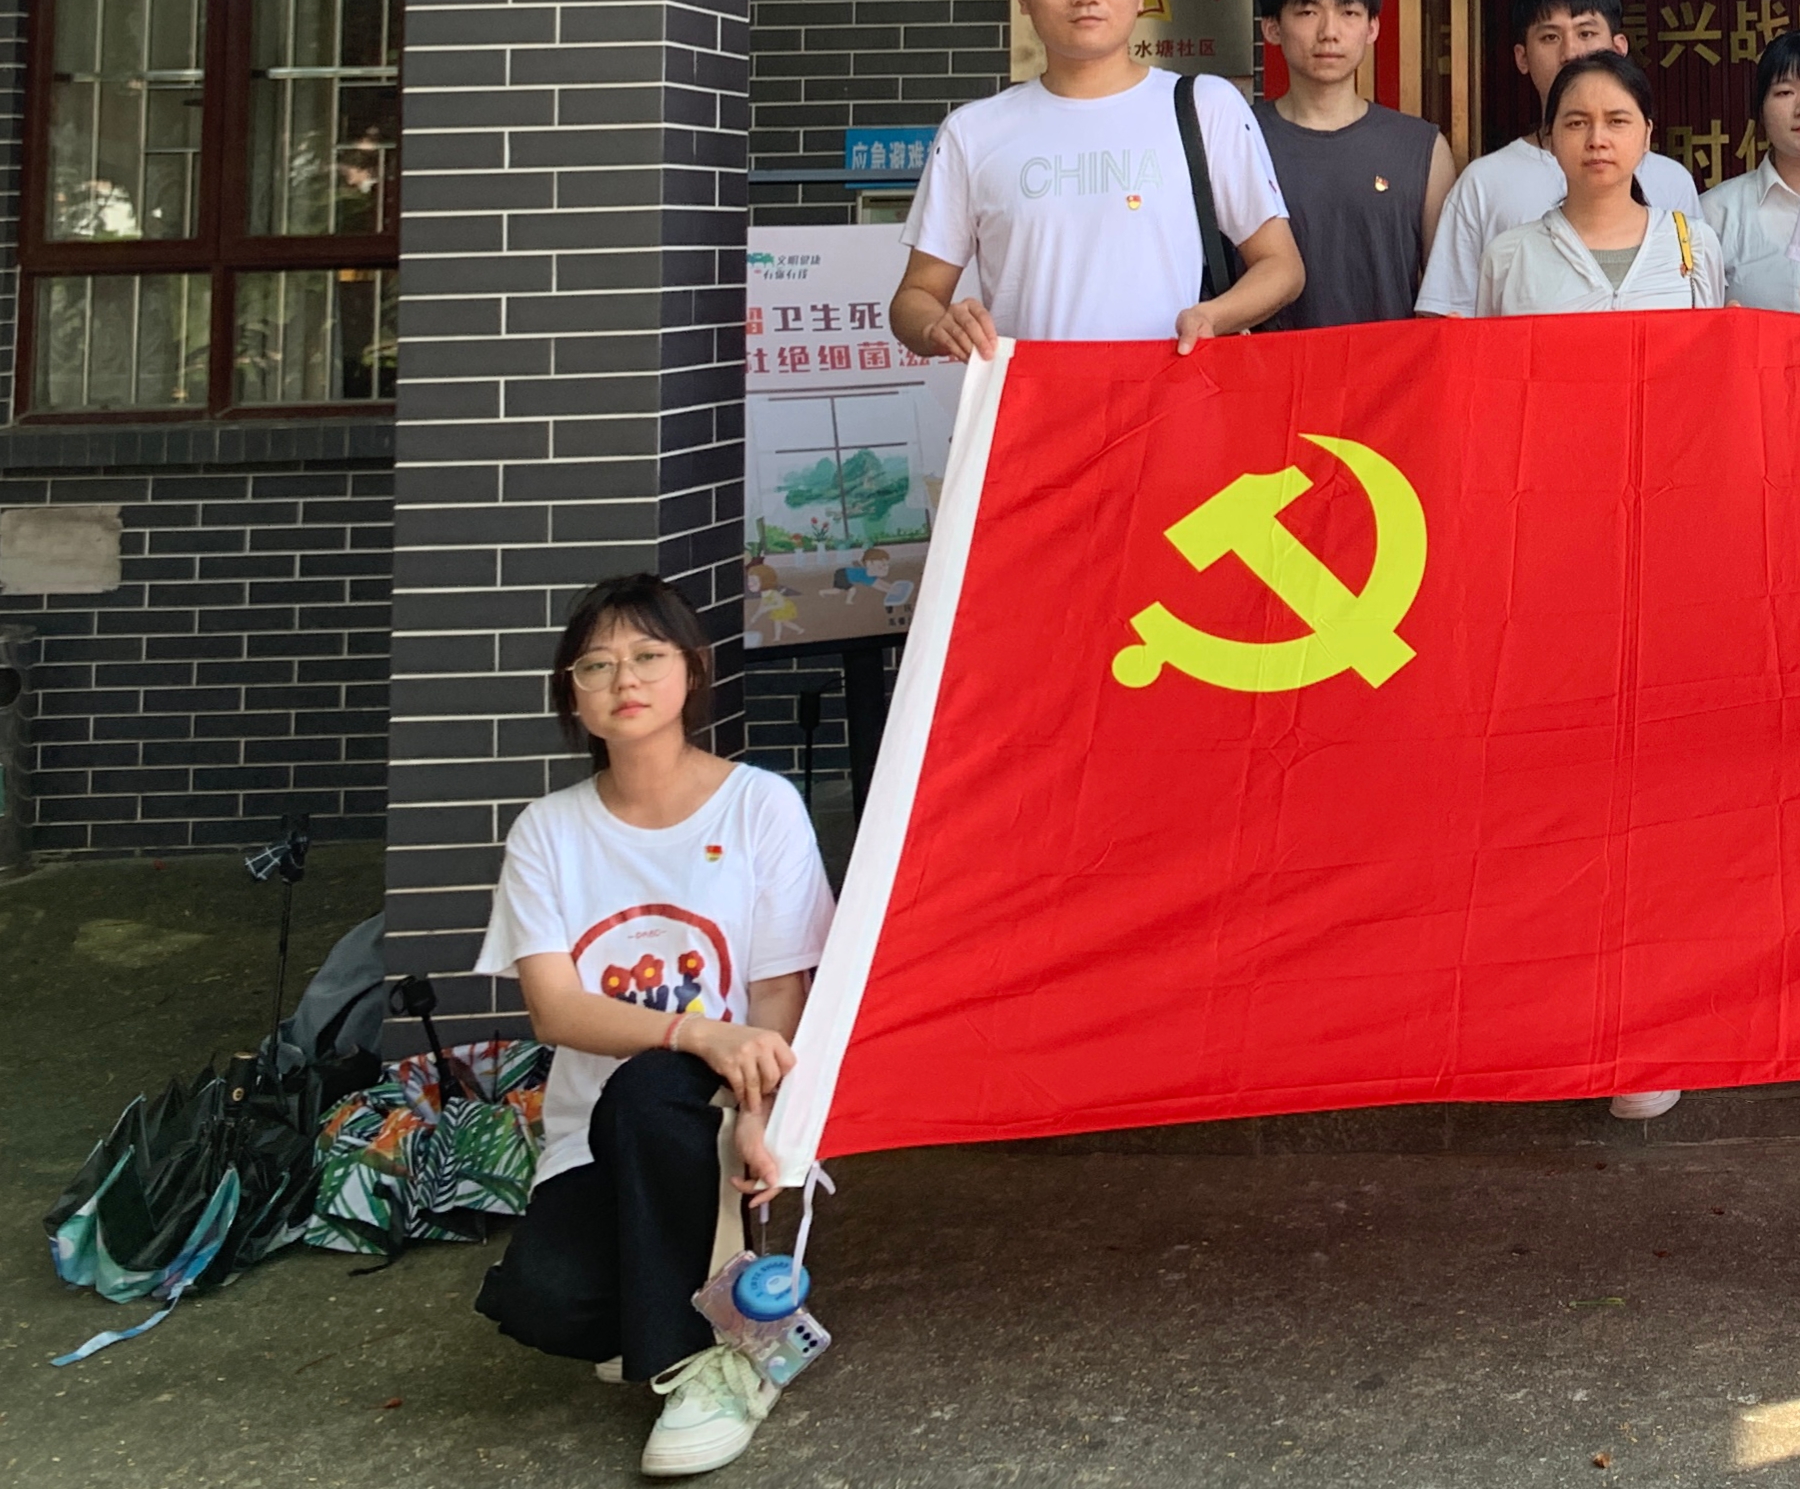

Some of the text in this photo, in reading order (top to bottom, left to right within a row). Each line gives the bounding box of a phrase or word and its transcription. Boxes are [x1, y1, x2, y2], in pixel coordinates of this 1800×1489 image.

[1127, 39, 1216, 57] 水塘社区
[851, 141, 934, 170] 应急避难
[1019, 149, 1164, 199] CHINA
